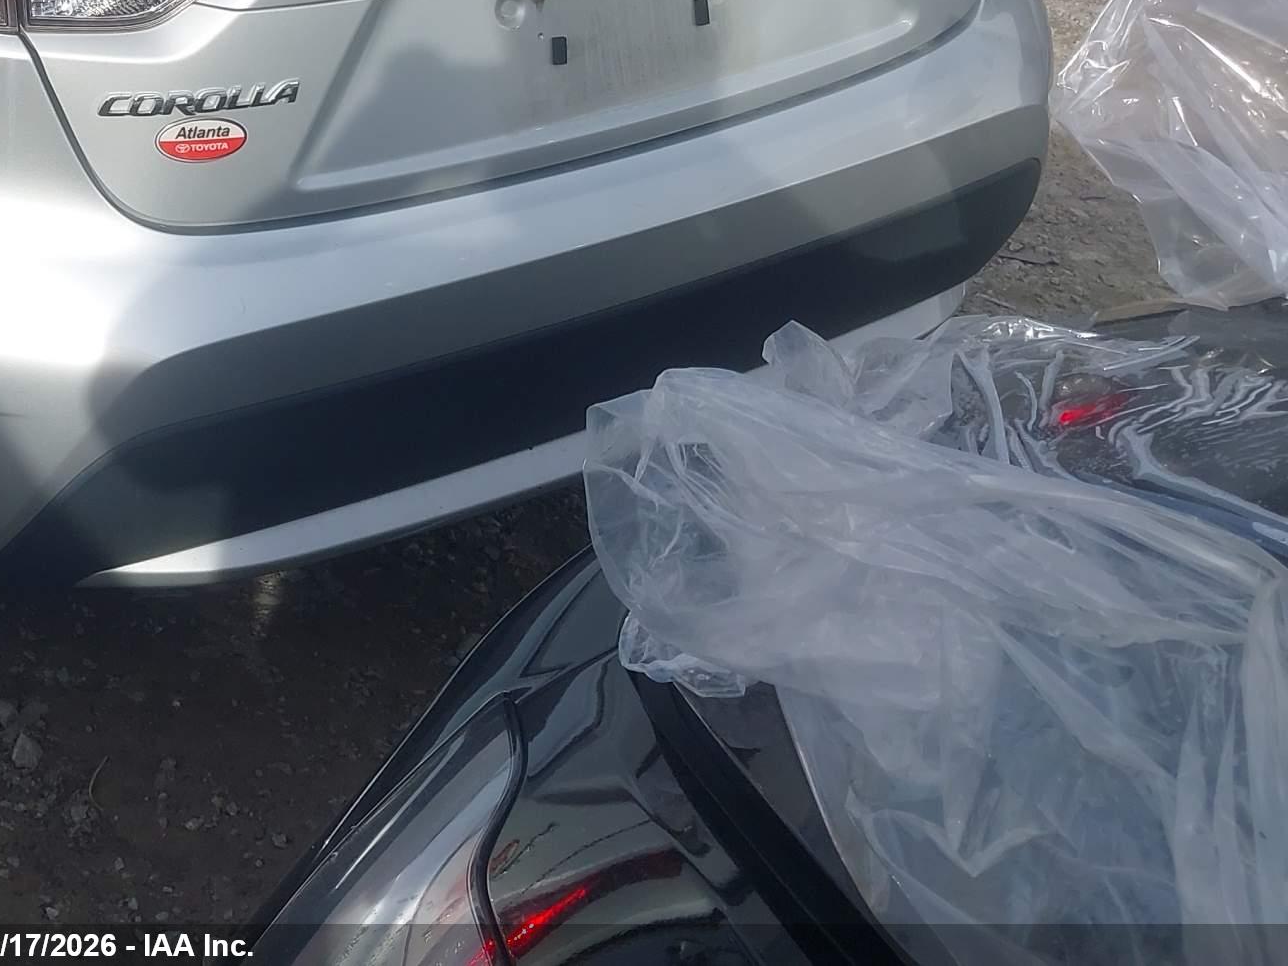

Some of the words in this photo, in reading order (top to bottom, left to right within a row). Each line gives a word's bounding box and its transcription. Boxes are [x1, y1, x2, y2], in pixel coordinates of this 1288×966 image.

[97, 78, 300, 117] COROLLA
[175, 124, 231, 140] Atlanta
[190, 142, 229, 152] TOYOTA
